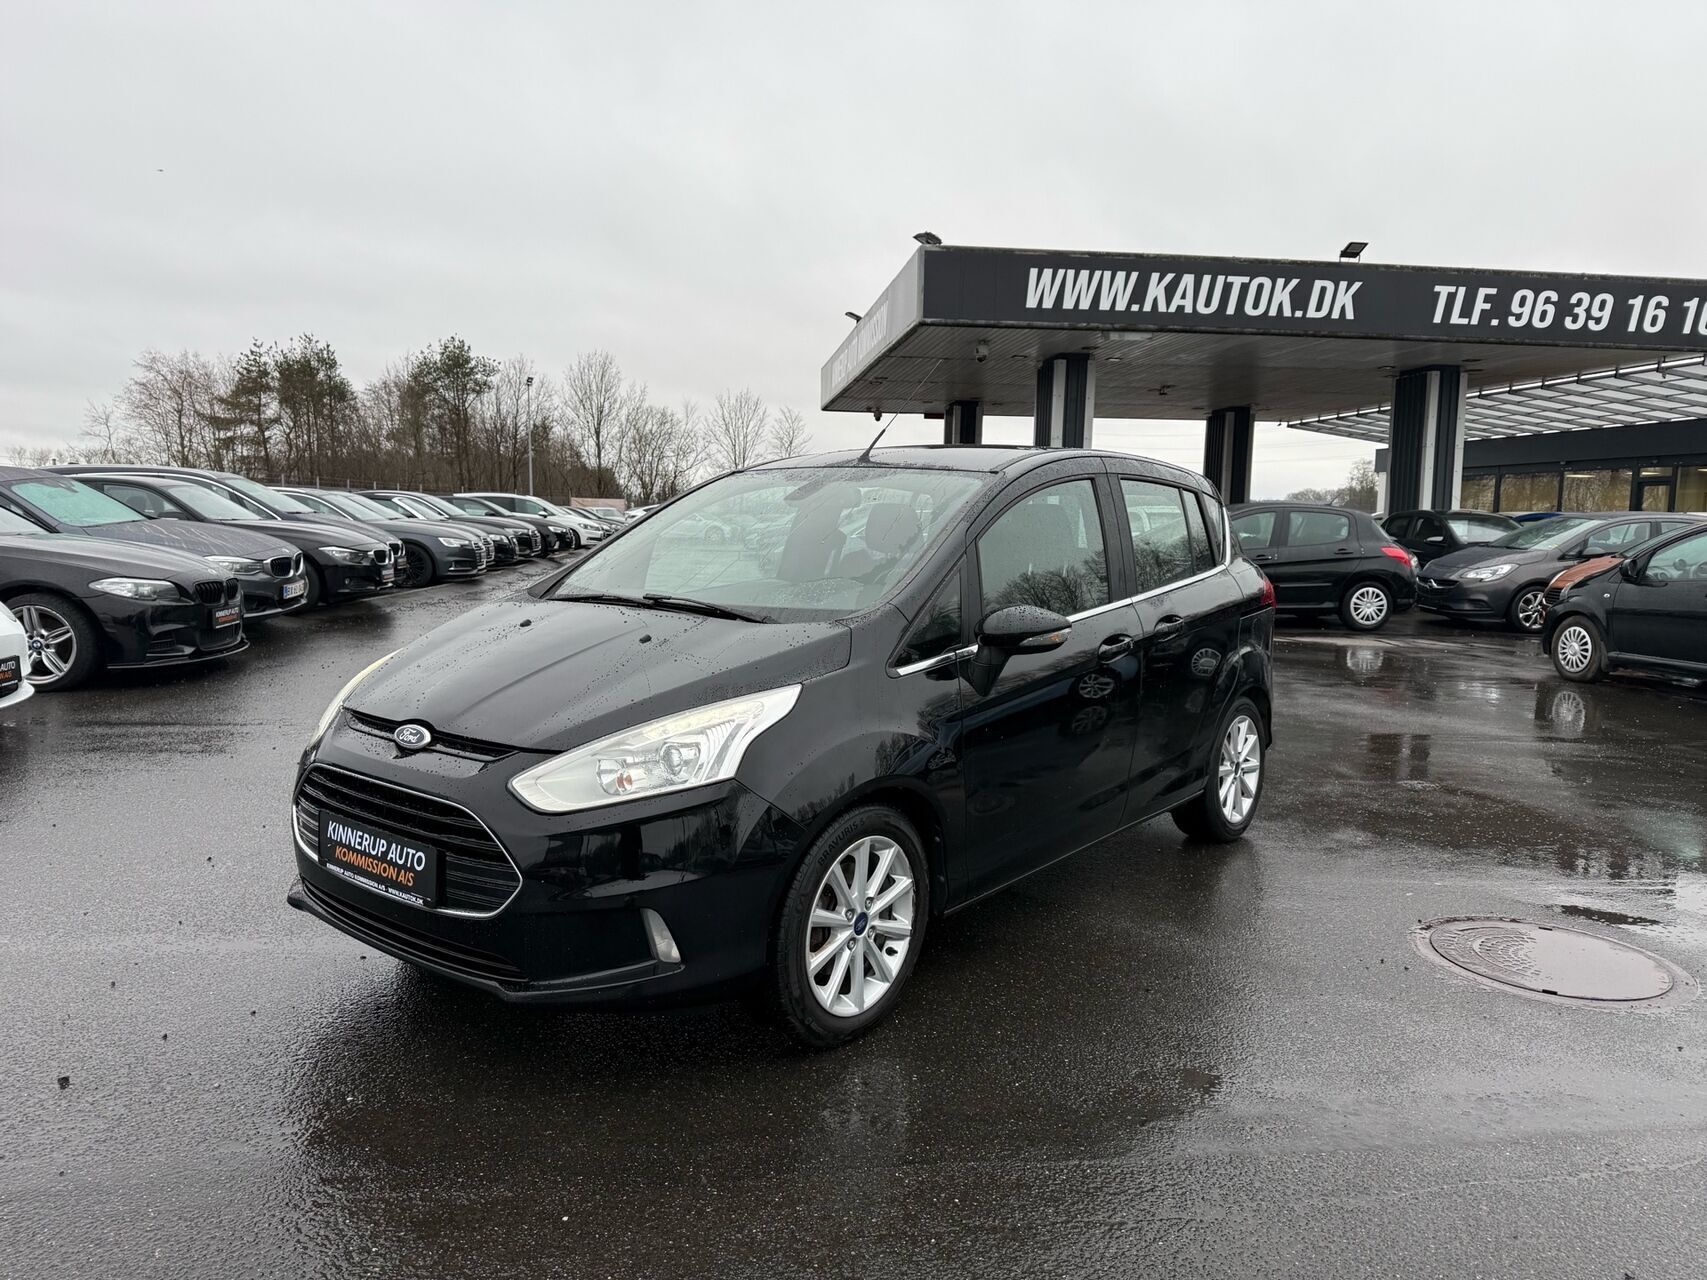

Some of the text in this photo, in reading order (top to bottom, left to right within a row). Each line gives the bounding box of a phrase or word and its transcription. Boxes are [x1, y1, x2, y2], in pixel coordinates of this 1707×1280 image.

[1025, 267, 1363, 320] WWW.KAUTOK.DK
[1432, 285, 1500, 326] TLF.
[1508, 288, 1559, 329] 96
[1564, 291, 1614, 331] 39
[1627, 295, 1670, 334] 16
[0, 660, 15, 671] AUTO
[399, 727, 421, 743] Ford
[327, 820, 426, 871] KINNERUP AUTO
[817, 820, 858, 866] BRAVURIS
[326, 862, 344, 874] KINNERUP
[344, 870, 355, 879] AUTO
[335, 845, 415, 887] KOMMISSION A/S
